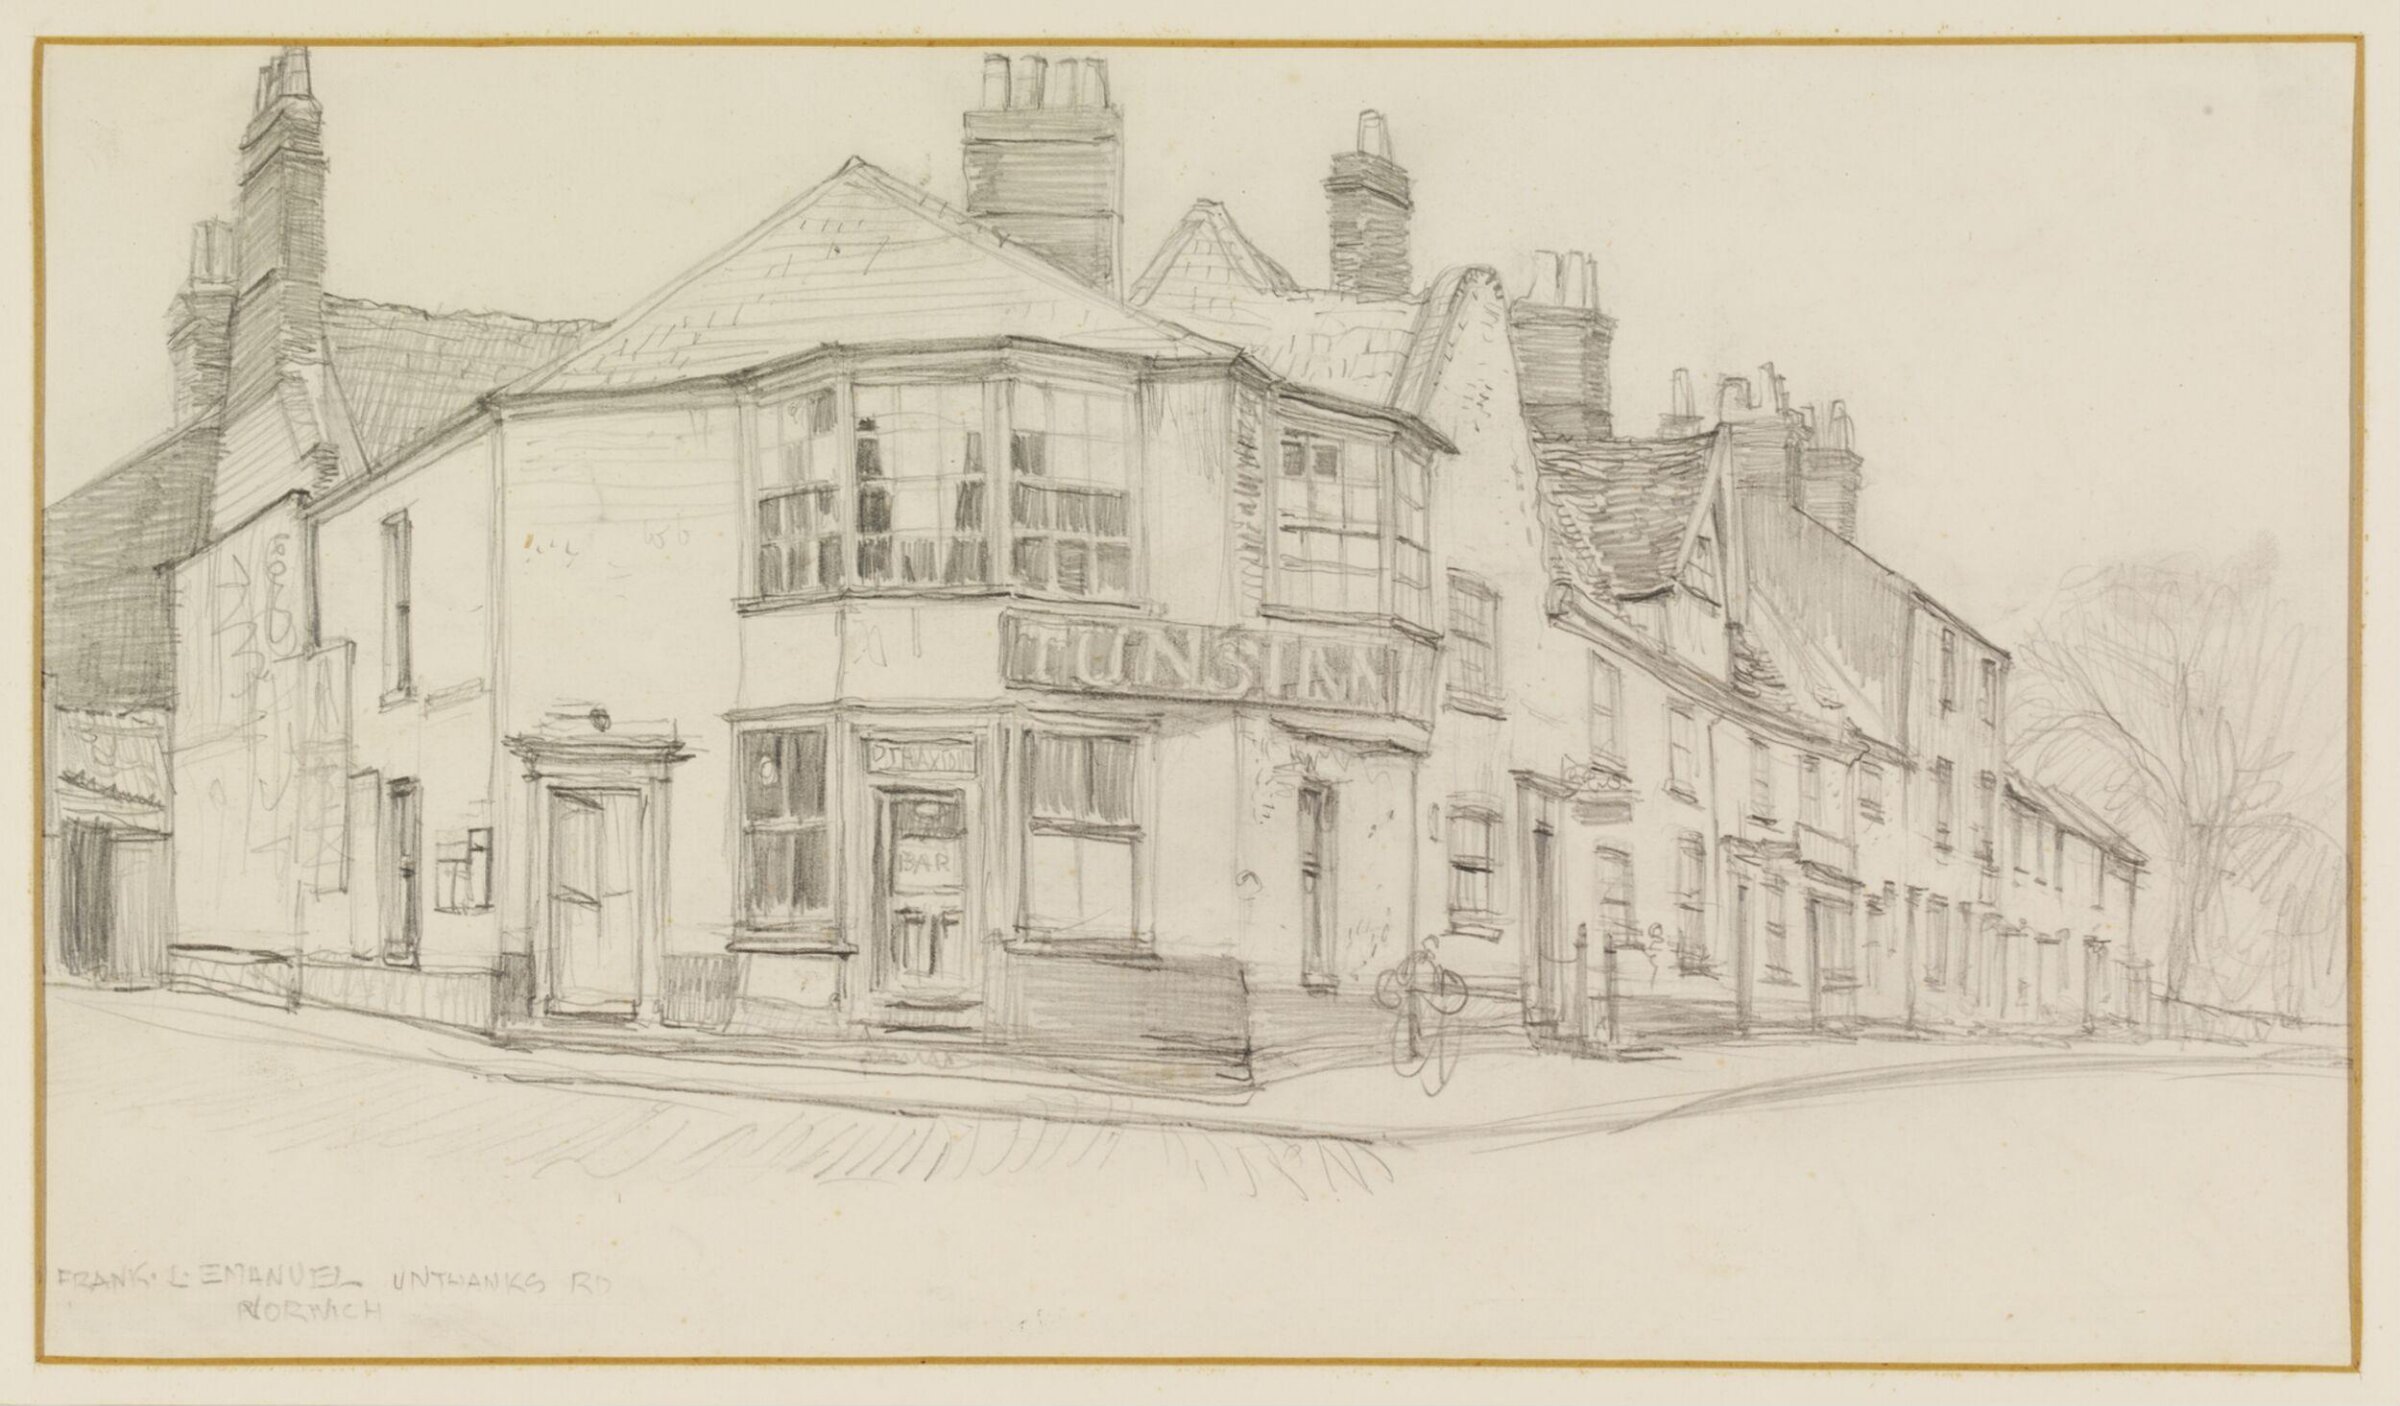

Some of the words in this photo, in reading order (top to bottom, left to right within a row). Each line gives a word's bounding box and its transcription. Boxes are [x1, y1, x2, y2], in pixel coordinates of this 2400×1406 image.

[898, 850, 951, 874] BAR
[199, 1262, 363, 1289] EMANUEL
[393, 1265, 546, 1294] UNTHANKS
[570, 1270, 612, 1294] RD
[239, 1297, 381, 1322] NORWICH
